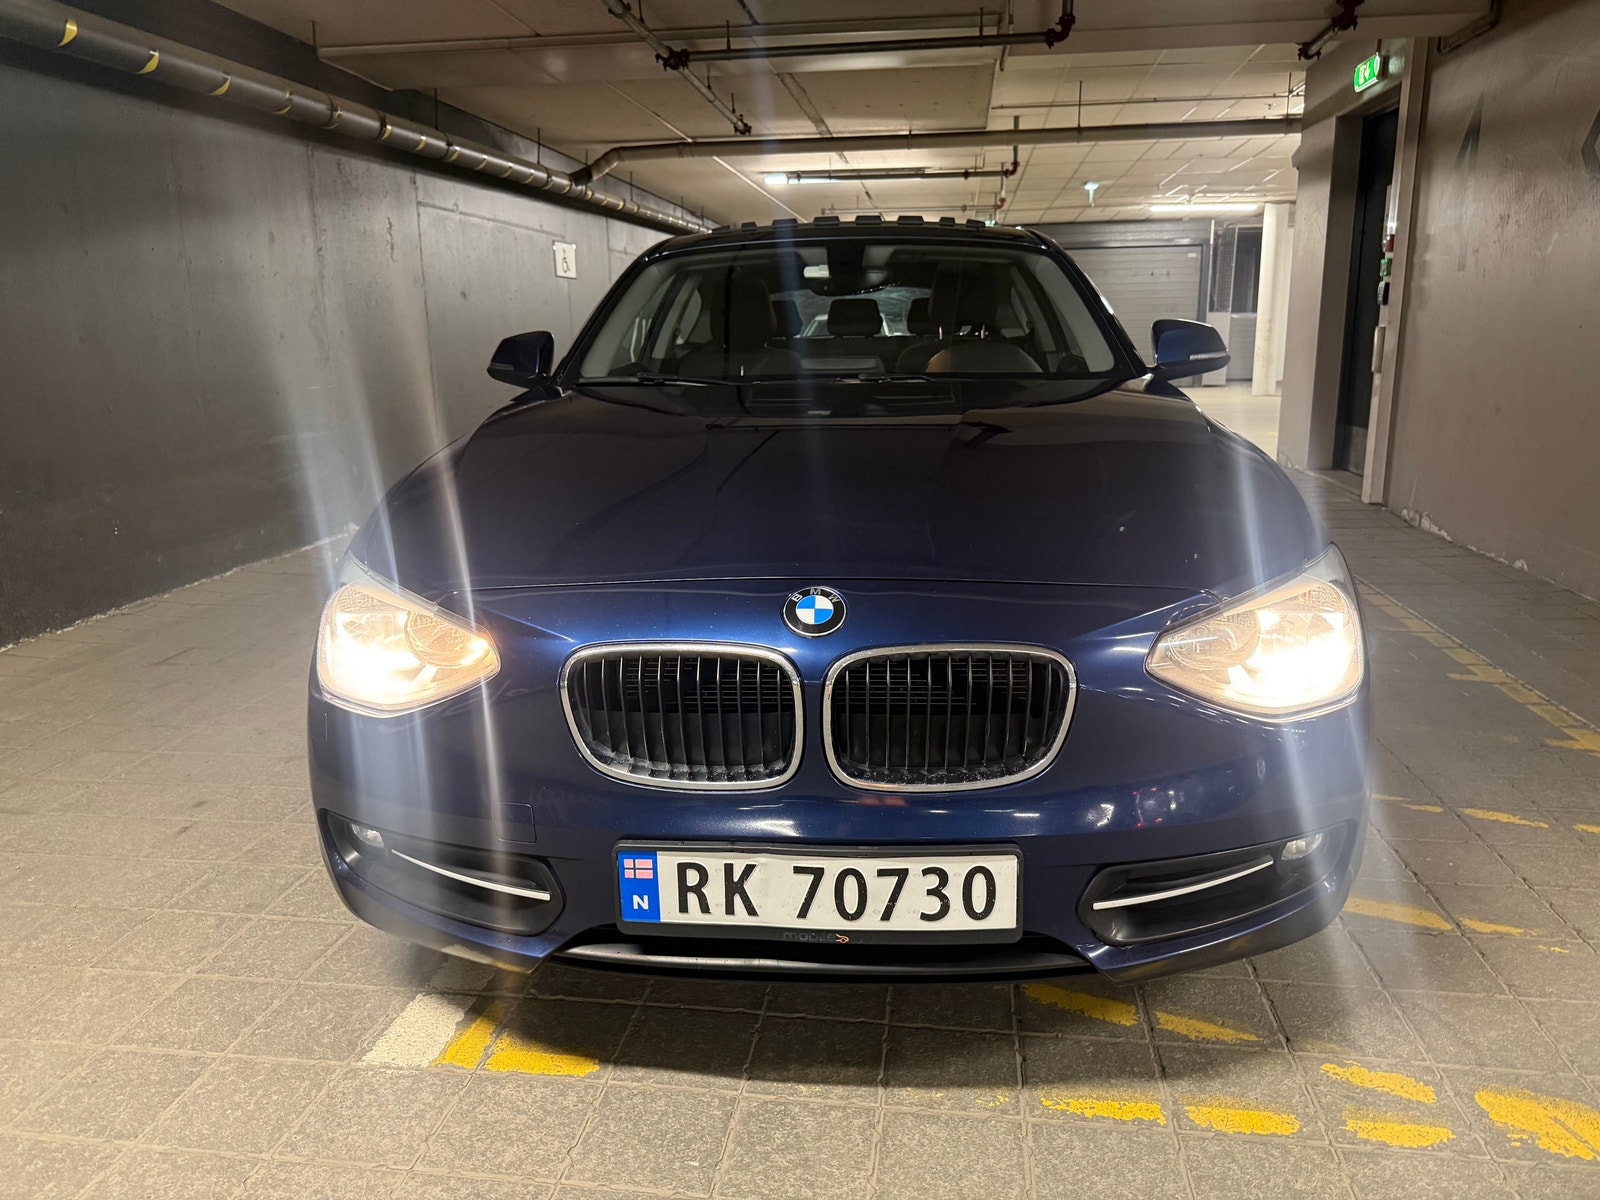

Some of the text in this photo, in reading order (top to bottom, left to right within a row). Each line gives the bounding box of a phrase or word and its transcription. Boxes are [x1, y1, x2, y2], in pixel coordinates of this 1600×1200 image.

[791, 588, 841, 603] BMW
[677, 862, 997, 921] RK 70730
[632, 894, 649, 910] N
